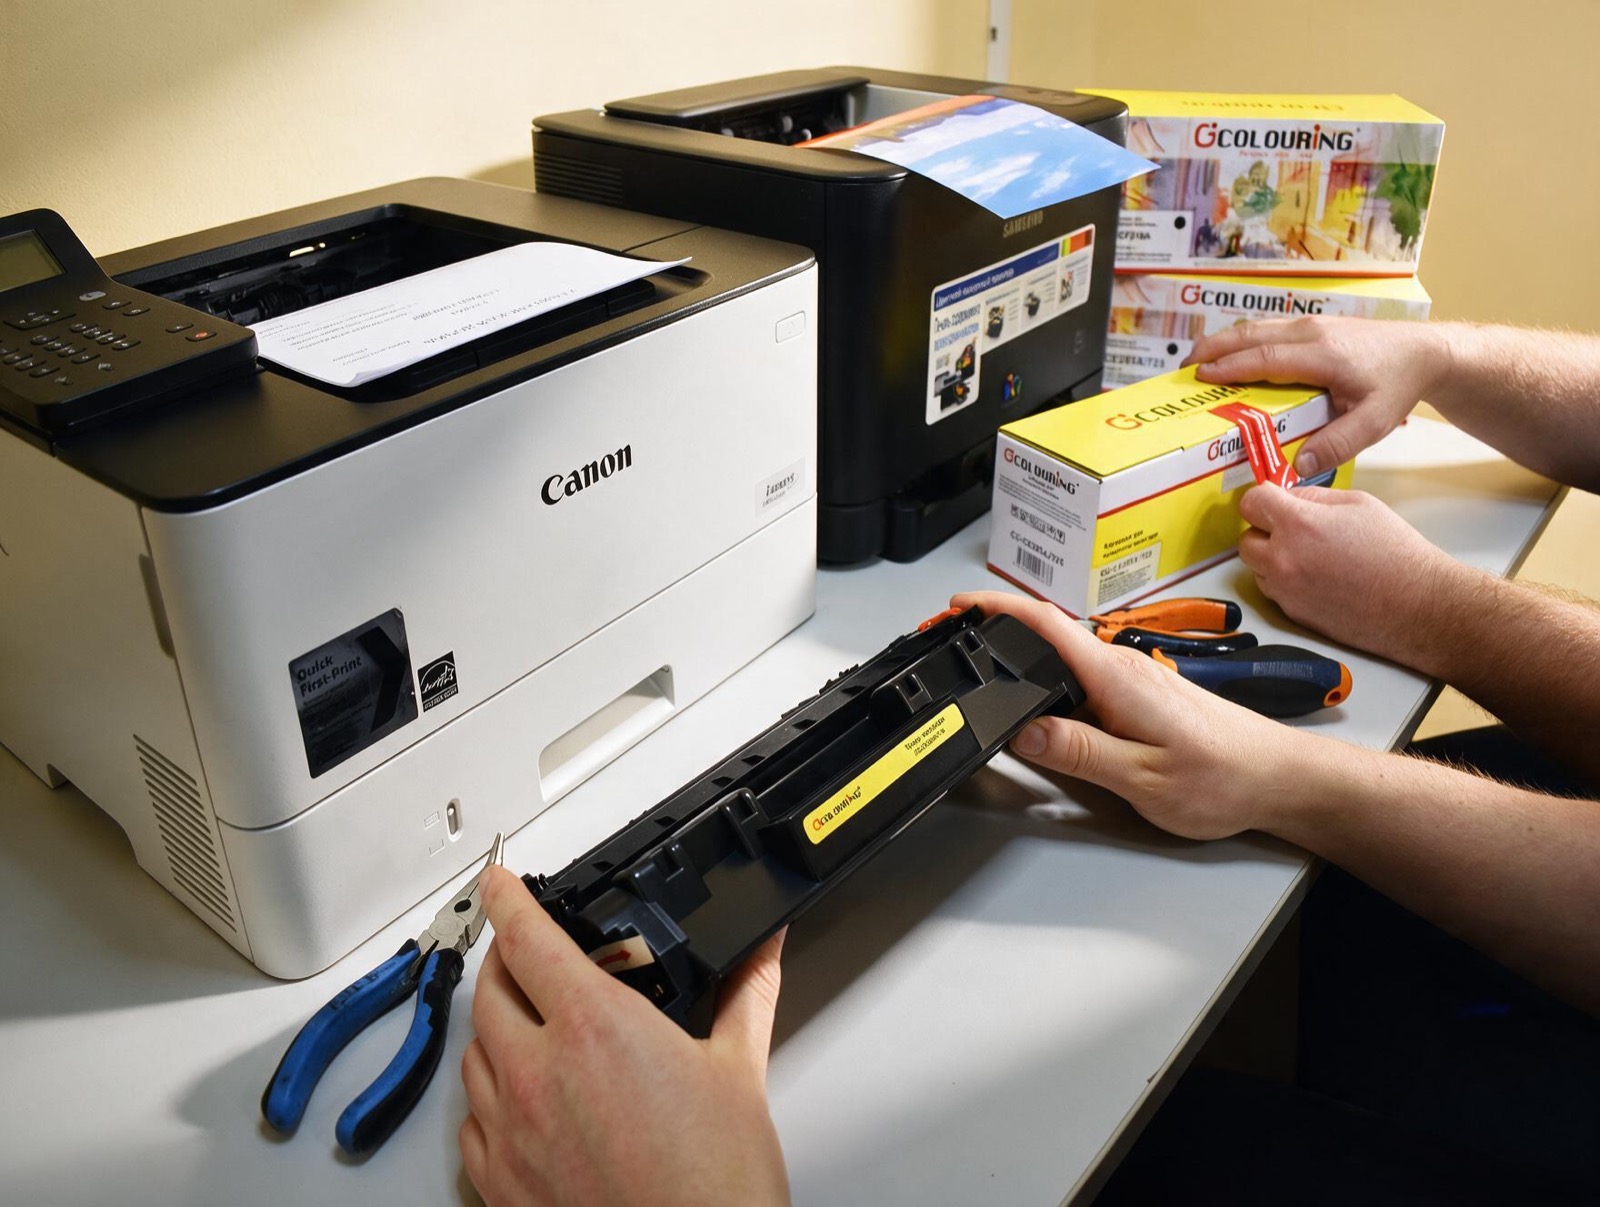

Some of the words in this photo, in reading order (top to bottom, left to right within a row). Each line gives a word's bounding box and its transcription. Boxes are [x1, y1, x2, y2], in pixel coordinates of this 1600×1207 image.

[541, 444, 632, 505] Canon
[297, 655, 333, 683] Quick
[300, 656, 362, 697] First-Print
